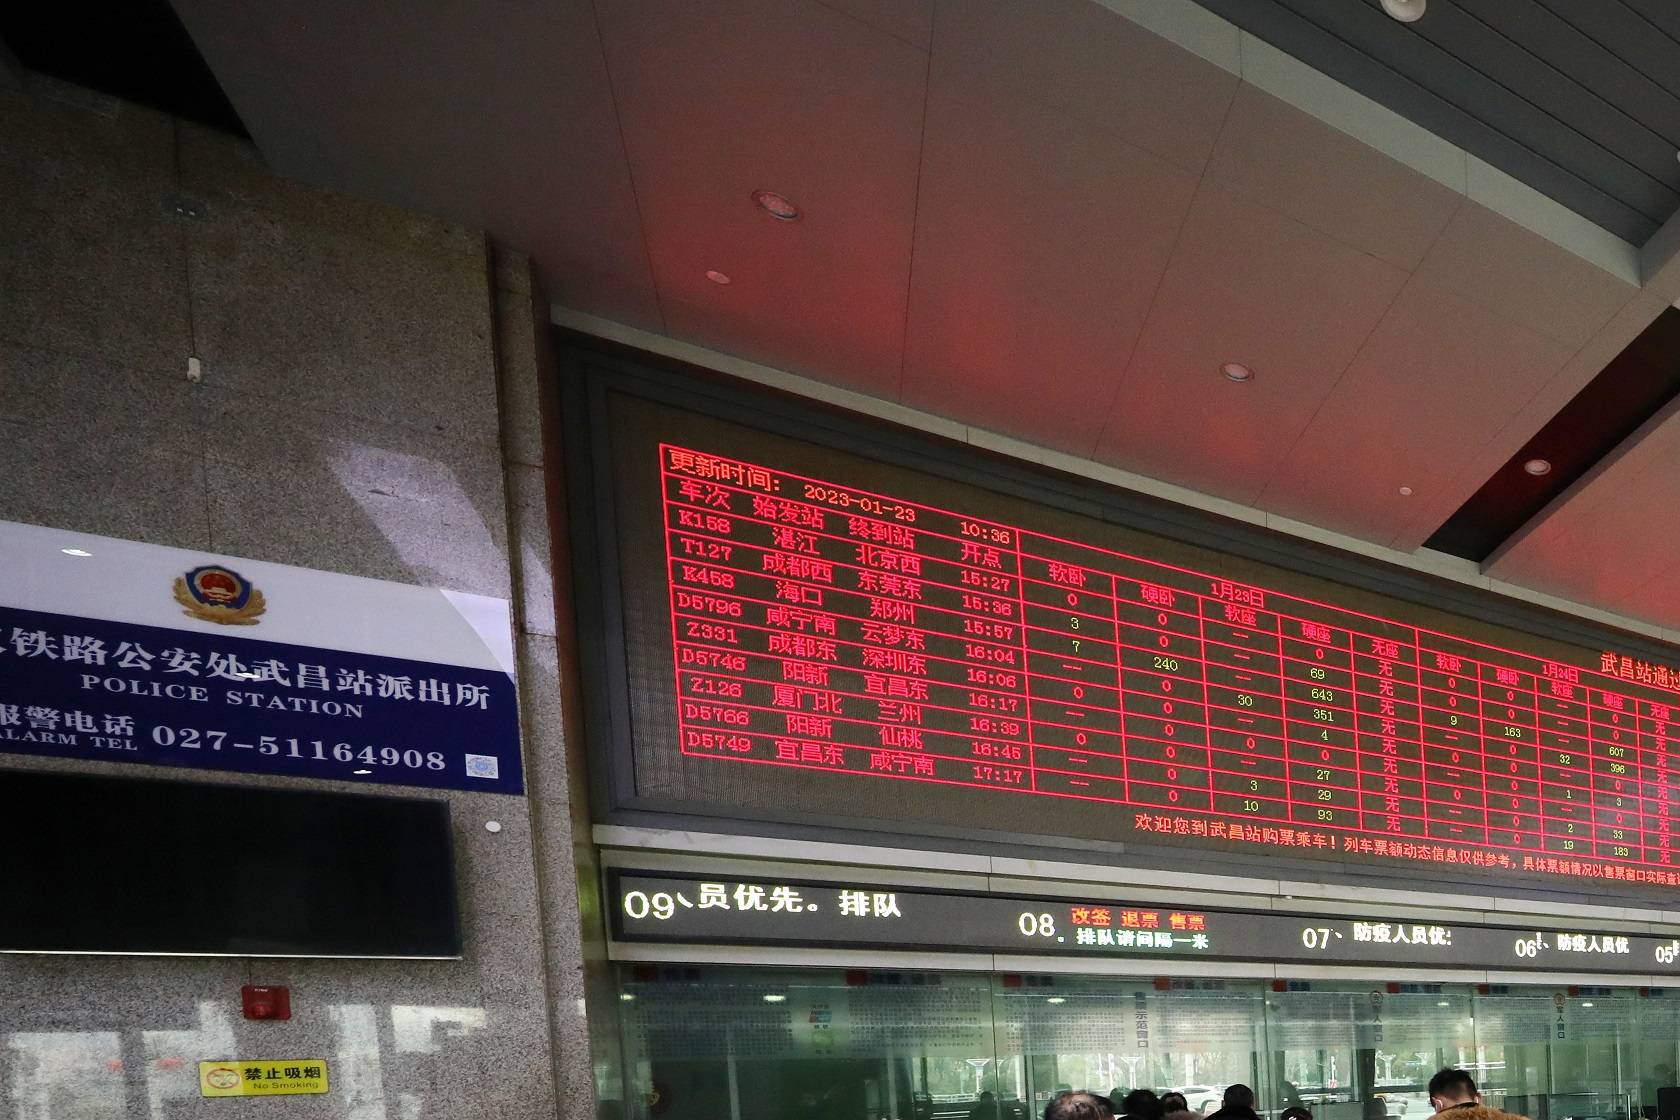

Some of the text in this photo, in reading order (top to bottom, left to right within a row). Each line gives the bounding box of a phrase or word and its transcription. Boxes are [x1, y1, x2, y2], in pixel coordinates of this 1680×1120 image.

[804, 484, 915, 522] 2023-01-23
[961, 522, 1010, 544] 10:36
[679, 480, 731, 509] 车次
[752, 496, 824, 529] 始发站
[848, 517, 915, 549] 终到站
[961, 542, 1002, 568] 开点
[1048, 562, 1087, 587] 软卧
[1140, 584, 1176, 607] 硬卧
[1224, 605, 1257, 626] 软座
[1300, 622, 1332, 644] 硬座
[1372, 639, 1399, 658] 无座
[679, 510, 1393, 677] K158 湛江 北京西 15:27 0 0 0 无
[1211, 582, 1264, 608] 1月23日
[681, 538, 1394, 696] T127 成都西 东莞东 15:36 3 0 69 无
[0, 627, 490, 710] 铁路公安处武昌站派出所
[678, 592, 742, 617] D5796
[766, 606, 836, 636] 咸宁南
[861, 623, 925, 651] 云梦东
[966, 644, 1015, 665] 16:04
[1162, 679, 1172, 692] 0
[1237, 694, 1253, 707] 30
[1313, 709, 1334, 722] 351
[1381, 719, 1396, 735] 无
[1559, 755, 1571, 764] 32
[682, 566, 735, 588] K458
[776, 580, 822, 606] 海口
[870, 598, 915, 624] 郑州
[964, 619, 1013, 640] 15:57
[1072, 640, 1081, 653] 7
[1153, 656, 1178, 671] 240
[1311, 689, 1333, 701] 643
[1380, 699, 1395, 716] 无
[1450, 716, 1458, 726] 9
[1504, 727, 1521, 738] 163
[81, 674, 363, 718] POLICE STATION
[682, 648, 746, 671] D5746
[782, 661, 829, 686] 阳新
[864, 673, 929, 700] 宜昌东
[969, 692, 1017, 712] 16:17
[1164, 724, 1174, 736] 0
[1246, 737, 1256, 748] 0
[1321, 750, 1329, 761] 0
[1383, 757, 1398, 774] 无
[686, 621, 1397, 755] Z331 成都东 深圳东 16:06 0 0 4 无
[90, 736, 137, 751] TEL
[152, 726, 446, 771] 027-51164908
[685, 704, 750, 726] D5766
[786, 714, 833, 739] 阳新
[879, 726, 924, 750] 仙桃
[972, 741, 1021, 760] 16:45
[1167, 768, 1177, 780] 0
[1250, 780, 1258, 791] 3
[1317, 790, 1332, 801] 29
[1385, 796, 1400, 812] 无
[690, 677, 1399, 793] Z126 厦门北 兰州 16:39 0 0 27 无
[687, 732, 751, 752] D5749
[775, 739, 844, 765] 宜昌东
[870, 751, 935, 776] 咸宁南
[974, 766, 1023, 784] 17:17
[1168, 790, 1178, 801] 0
[1244, 800, 1259, 811] 10
[1317, 810, 1333, 821] 93
[1386, 815, 1401, 831] 无
[624, 891, 675, 919] 09
[839, 890, 902, 917] 排队
[1071, 908, 1111, 926] 改签
[1121, 911, 1159, 929] 退票
[1169, 913, 1205, 930] 售票
[1303, 928, 1330, 949] 07
[1515, 939, 1536, 958] 06
[1655, 946, 1673, 964] 05
[245, 1067, 320, 1080] 禁止吸烟
[272, 1082, 318, 1090] Smoking
